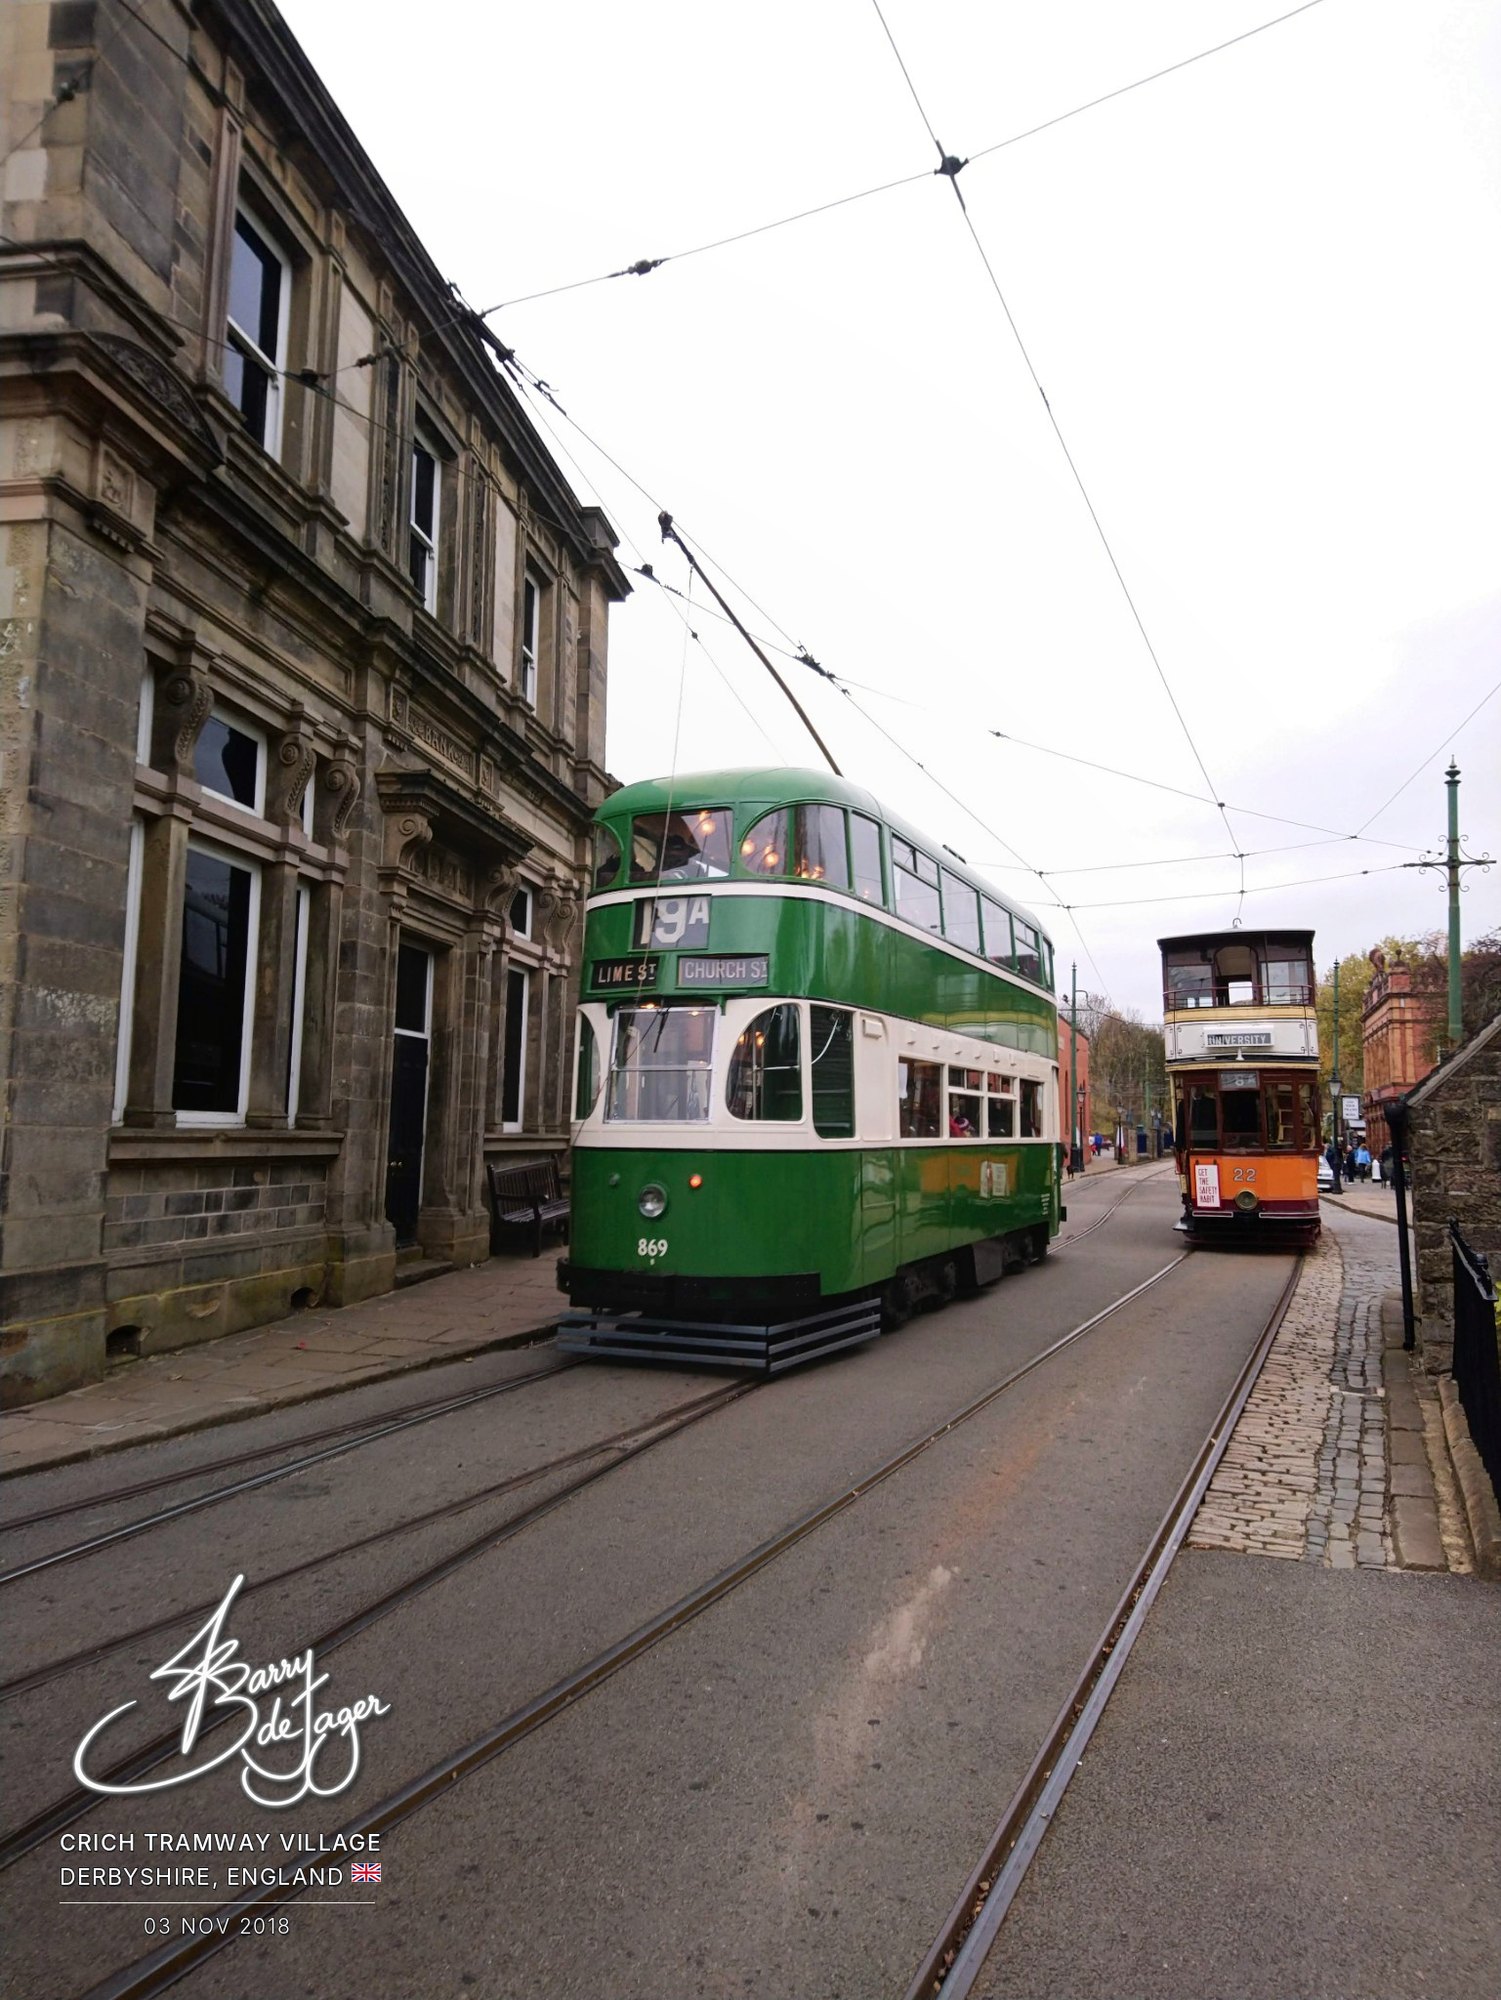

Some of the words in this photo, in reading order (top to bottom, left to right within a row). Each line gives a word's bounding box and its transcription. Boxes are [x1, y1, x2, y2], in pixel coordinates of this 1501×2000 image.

[640, 896, 710, 944] 19A
[598, 965, 633, 983] LIME
[637, 963, 657, 980] ST
[685, 961, 746, 979] CHURCH
[750, 960, 768, 978] ST
[1208, 1034, 1266, 1045] UNIVERSITY
[1197, 1168, 1208, 1177] GET
[1233, 1168, 1256, 1183] 22
[1198, 1177, 1209, 1186] THE
[1198, 1186, 1217, 1195] SAFETY
[1199, 1195, 1215, 1203] HABIT
[637, 1238, 668, 1257] 869
